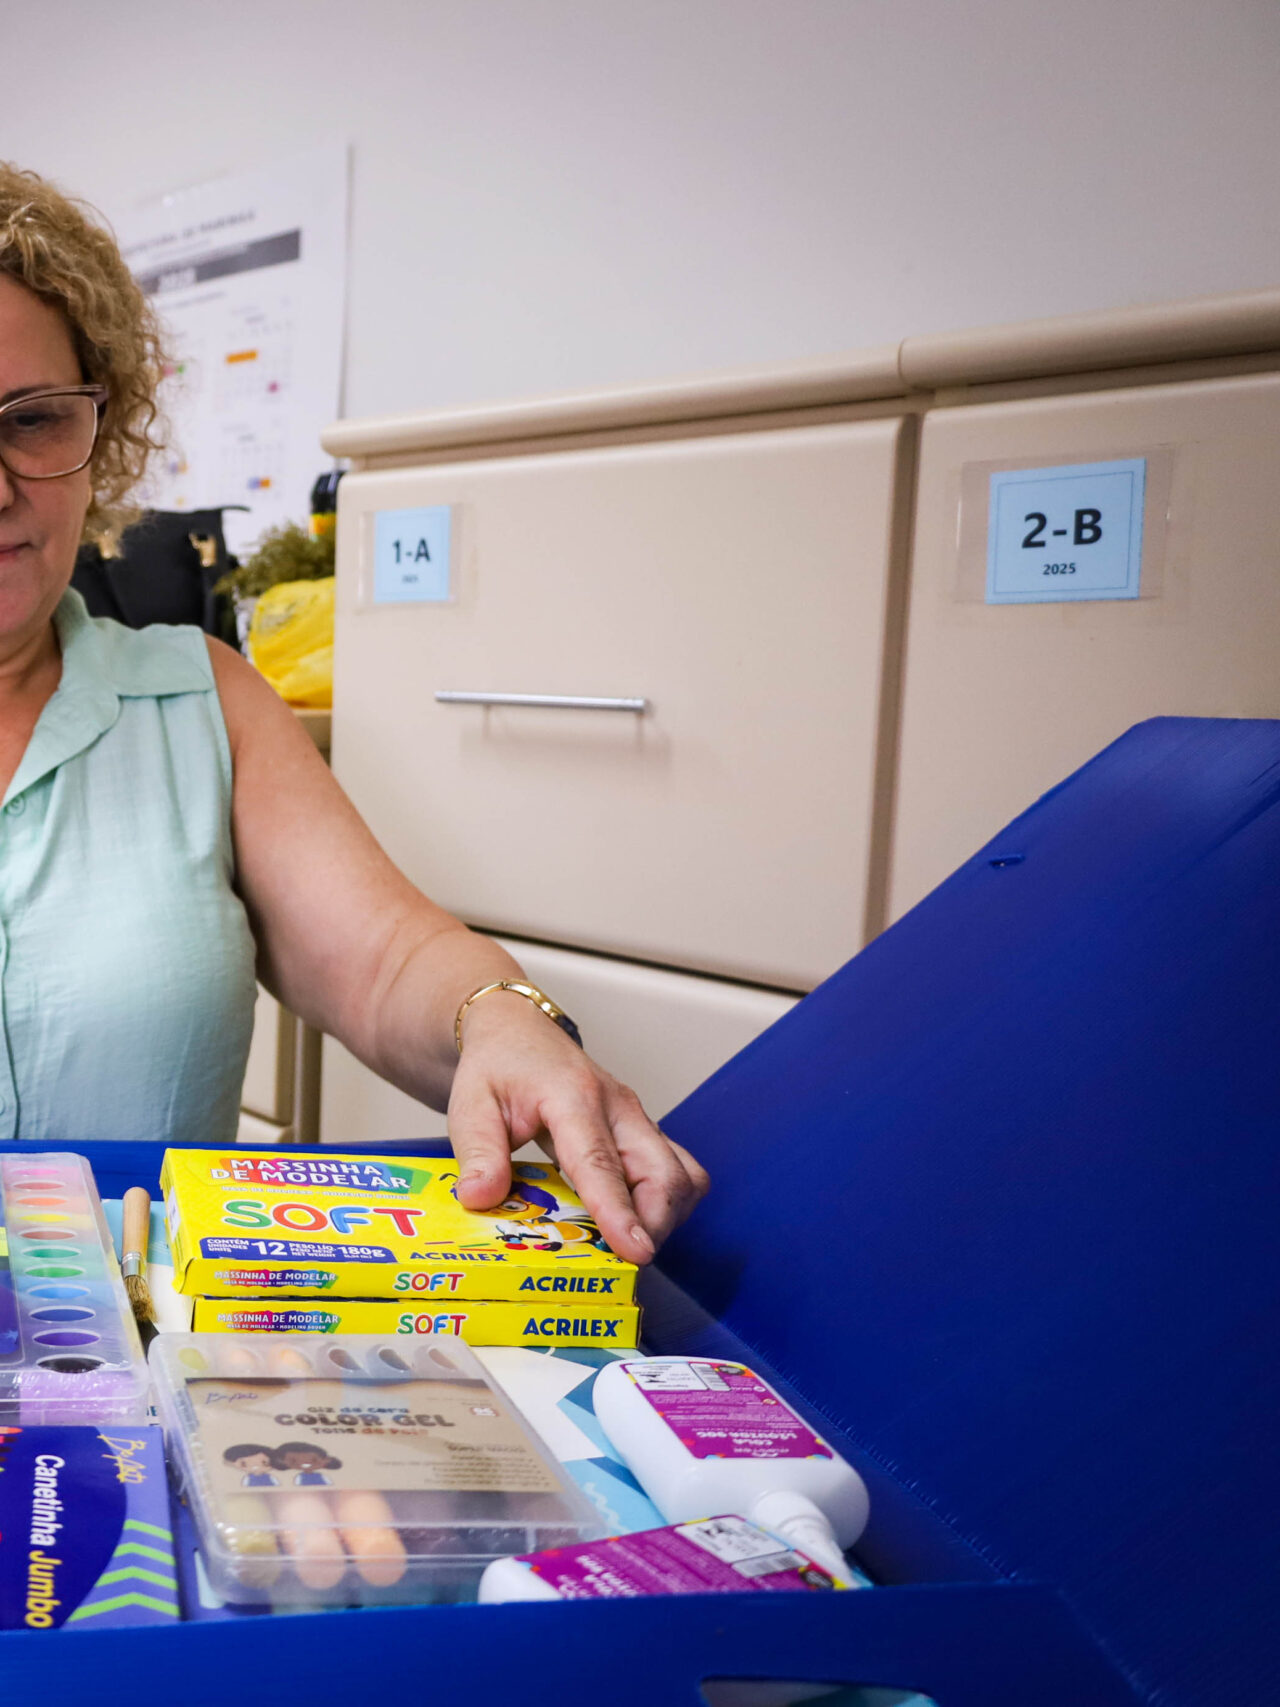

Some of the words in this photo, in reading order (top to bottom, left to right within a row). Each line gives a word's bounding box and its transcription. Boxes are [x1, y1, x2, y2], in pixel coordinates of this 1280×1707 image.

[1021, 508, 1103, 550] 2-B
[392, 537, 431, 564] 1-A
[1042, 562, 1077, 576] 2025
[230, 1159, 383, 1177] MASSINHA
[210, 1168, 251, 1182] DE
[261, 1170, 412, 1190] MODELAR
[223, 1200, 425, 1237] SOFT
[251, 1241, 288, 1256] 12
[337, 1246, 386, 1258] 180g
[409, 1251, 509, 1262] ACRILEX
[214, 1271, 266, 1280] MASSINHA
[269, 1272, 283, 1280] DE
[285, 1272, 336, 1281] MODELAR
[394, 1272, 464, 1292] SOFT
[519, 1276, 616, 1294] ACRILEX
[217, 1314, 269, 1323] MASSINHA
[272, 1314, 286, 1323] DE
[289, 1315, 339, 1324] MODELAR
[397, 1314, 467, 1336] SOFT
[523, 1318, 618, 1337] ACRILEX
[274, 1413, 382, 1426] COLOR
[392, 1414, 455, 1427] GEL
[30, 1454, 65, 1546] Canetinha
[25, 1550, 62, 1628] Jumbo
